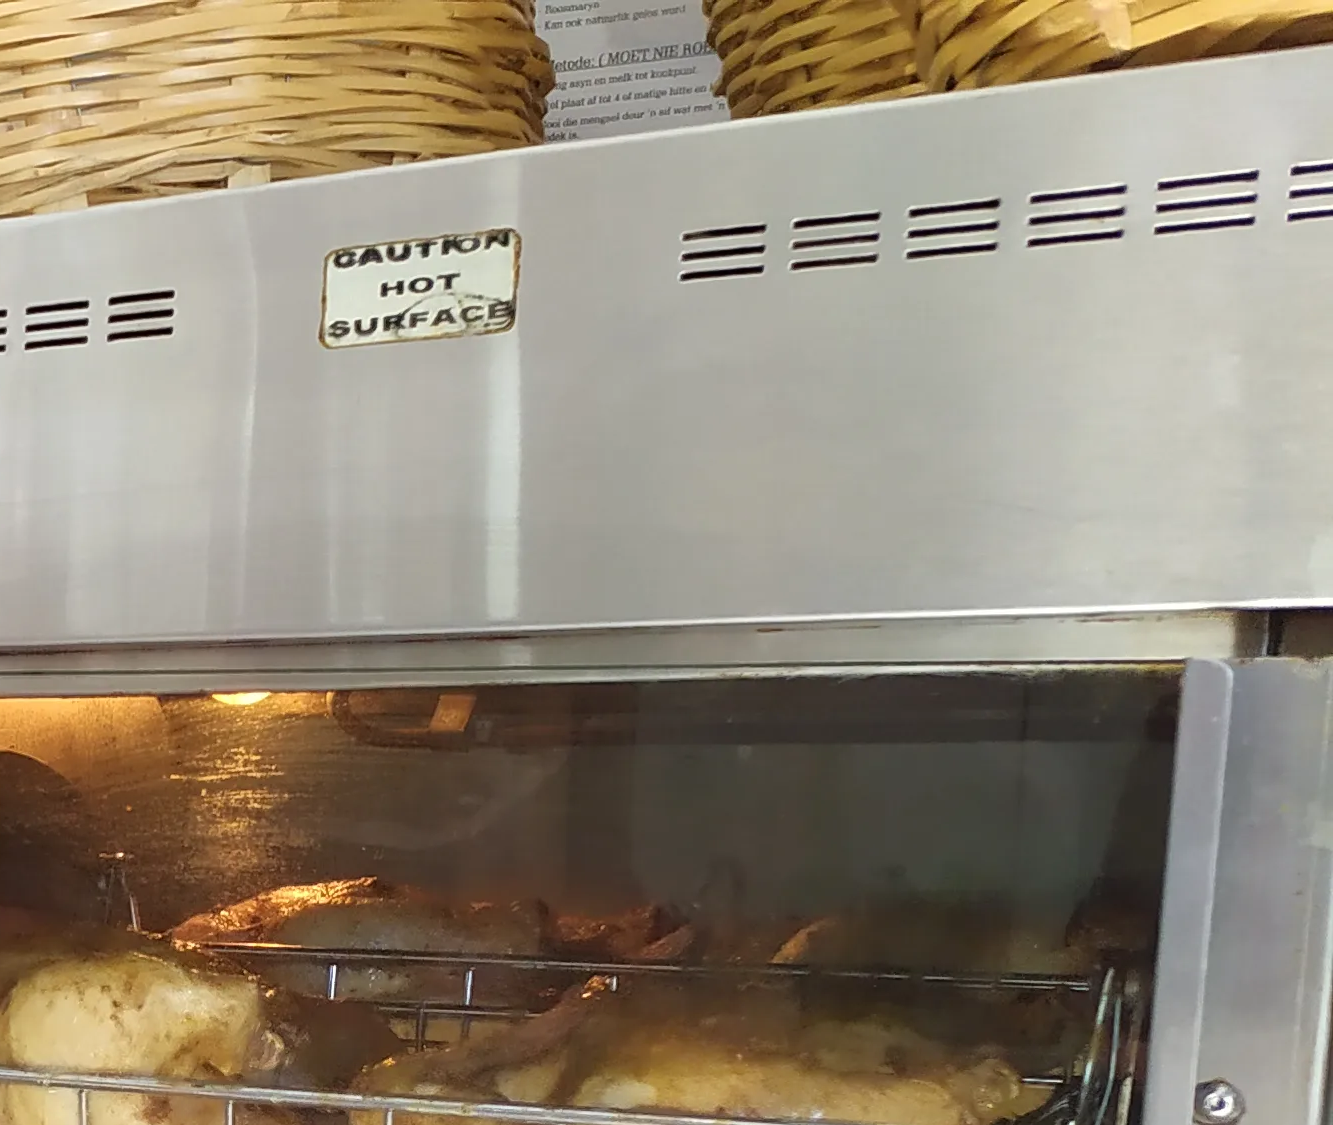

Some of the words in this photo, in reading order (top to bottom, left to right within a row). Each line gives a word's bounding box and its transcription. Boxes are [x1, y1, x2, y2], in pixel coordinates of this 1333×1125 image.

[544, 20, 563, 30] Kan
[551, 57, 595, 72] etode:
[607, 49, 650, 64] MOET
[654, 44, 679, 58] NIE
[569, 78, 592, 88] asyn
[594, 76, 606, 85] en
[608, 72, 633, 84] melk
[635, 71, 647, 80] tot
[599, 95, 612, 103] tot
[694, 86, 707, 94] en
[563, 116, 577, 127] die
[622, 111, 644, 121] deur
[674, 106, 691, 114] wat
[694, 104, 712, 113] met
[333, 230, 511, 269] CAUTION
[380, 272, 461, 299] HOT
[327, 299, 516, 338] SURFACE
